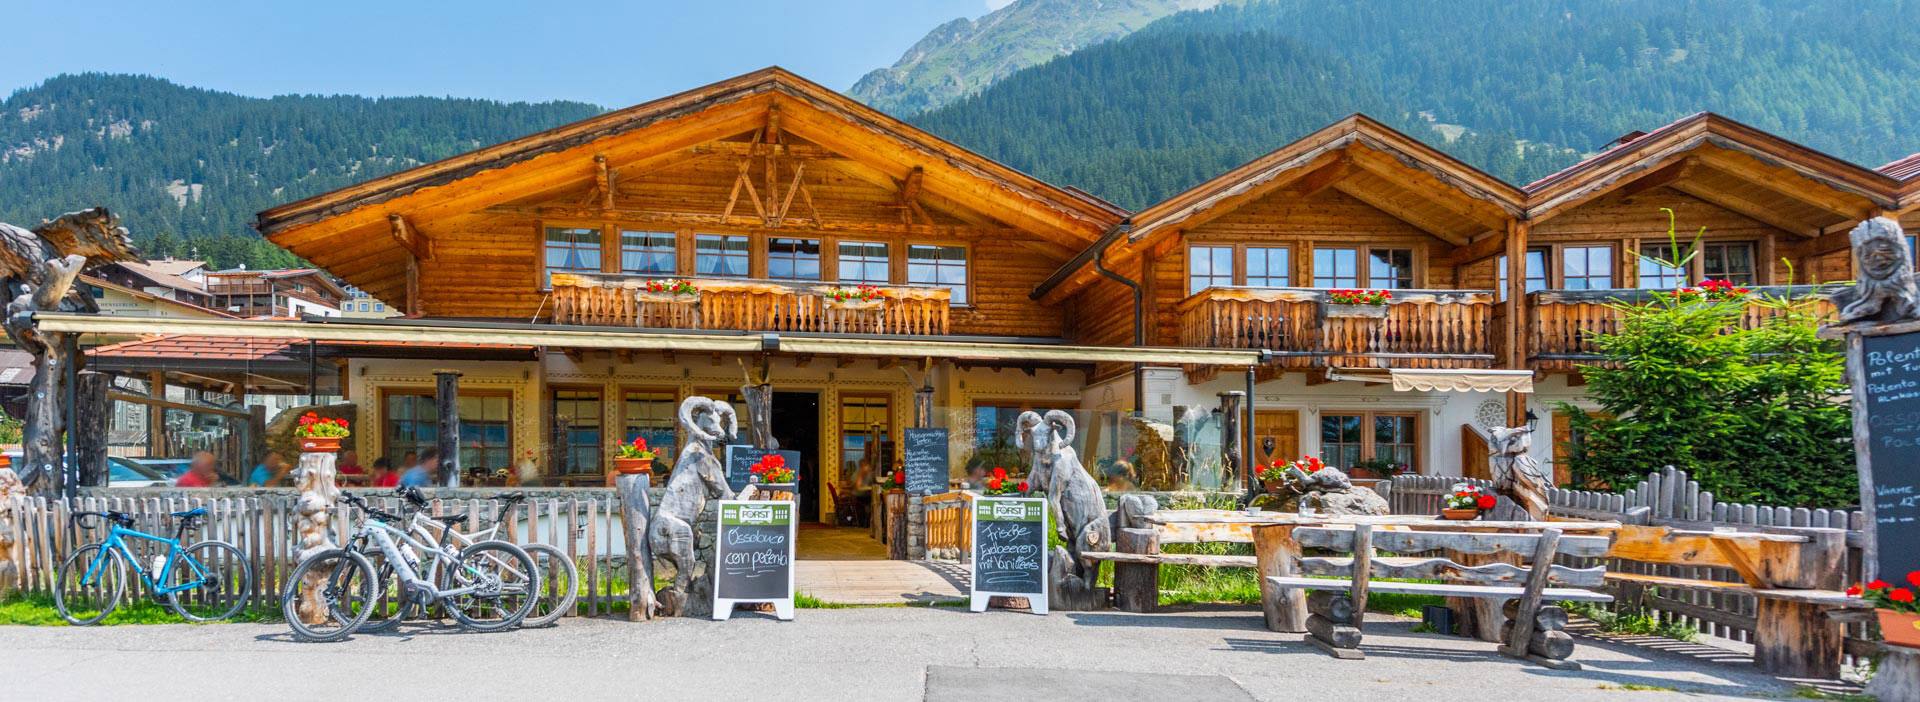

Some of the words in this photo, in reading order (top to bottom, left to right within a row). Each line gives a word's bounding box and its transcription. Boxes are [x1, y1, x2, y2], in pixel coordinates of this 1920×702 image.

[1867, 347, 1920, 366] Polent
[1871, 367, 1892, 378] mit
[742, 510, 771, 519] FORST
[996, 506, 1024, 515] FORST
[728, 527, 785, 546] Ossobuco
[982, 522, 1032, 542] Frische
[725, 551, 750, 565] con
[752, 548, 788, 571] polenta
[980, 543, 1038, 560] Erdbeeren
[978, 557, 993, 571] mit
